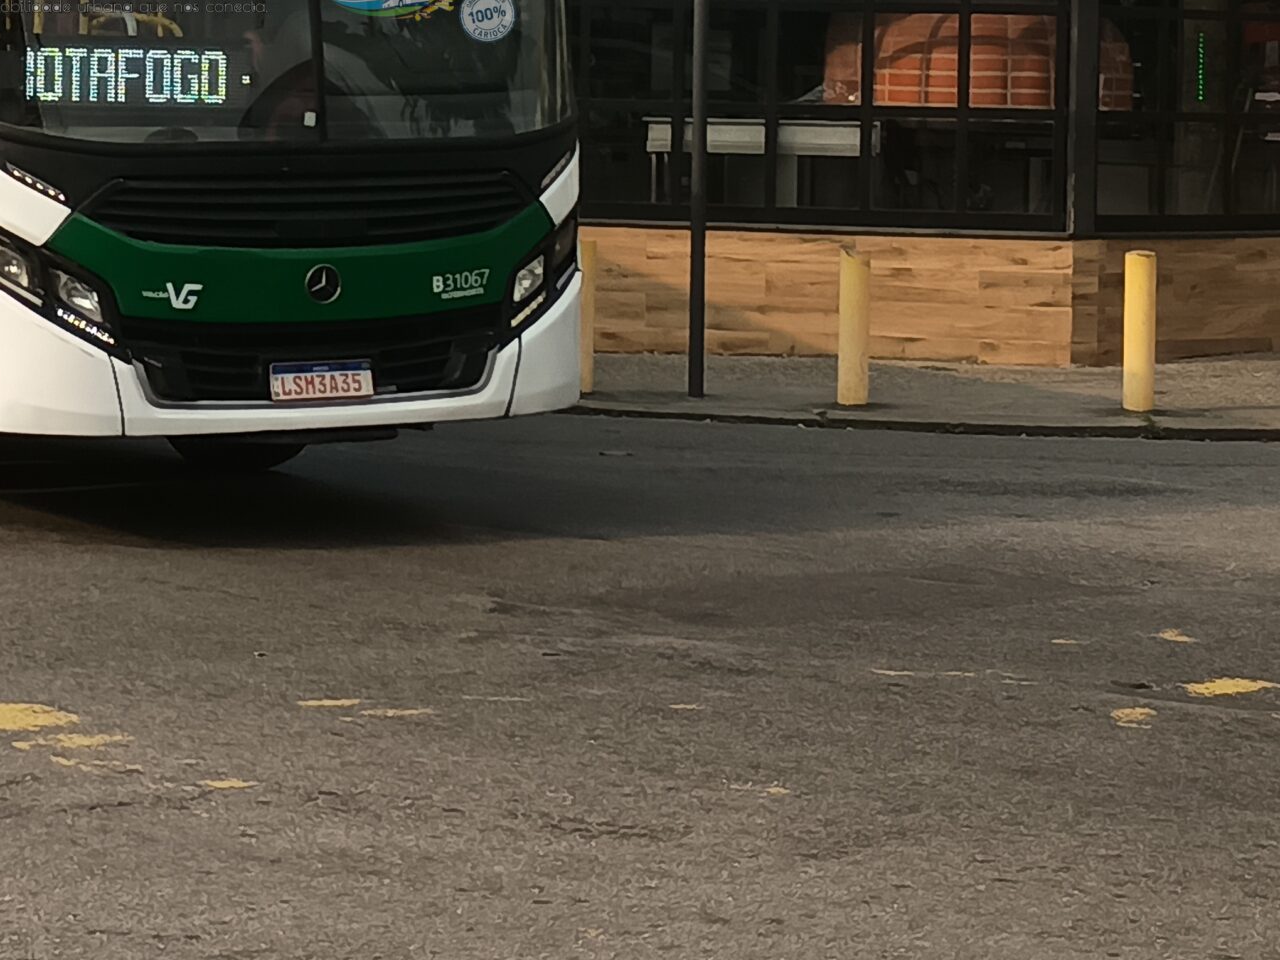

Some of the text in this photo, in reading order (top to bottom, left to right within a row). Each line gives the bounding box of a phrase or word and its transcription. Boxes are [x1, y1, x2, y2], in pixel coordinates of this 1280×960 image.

[468, 5, 506, 24] 100%
[473, 23, 507, 38] CARIOCA
[433, 269, 490, 293] B31067
